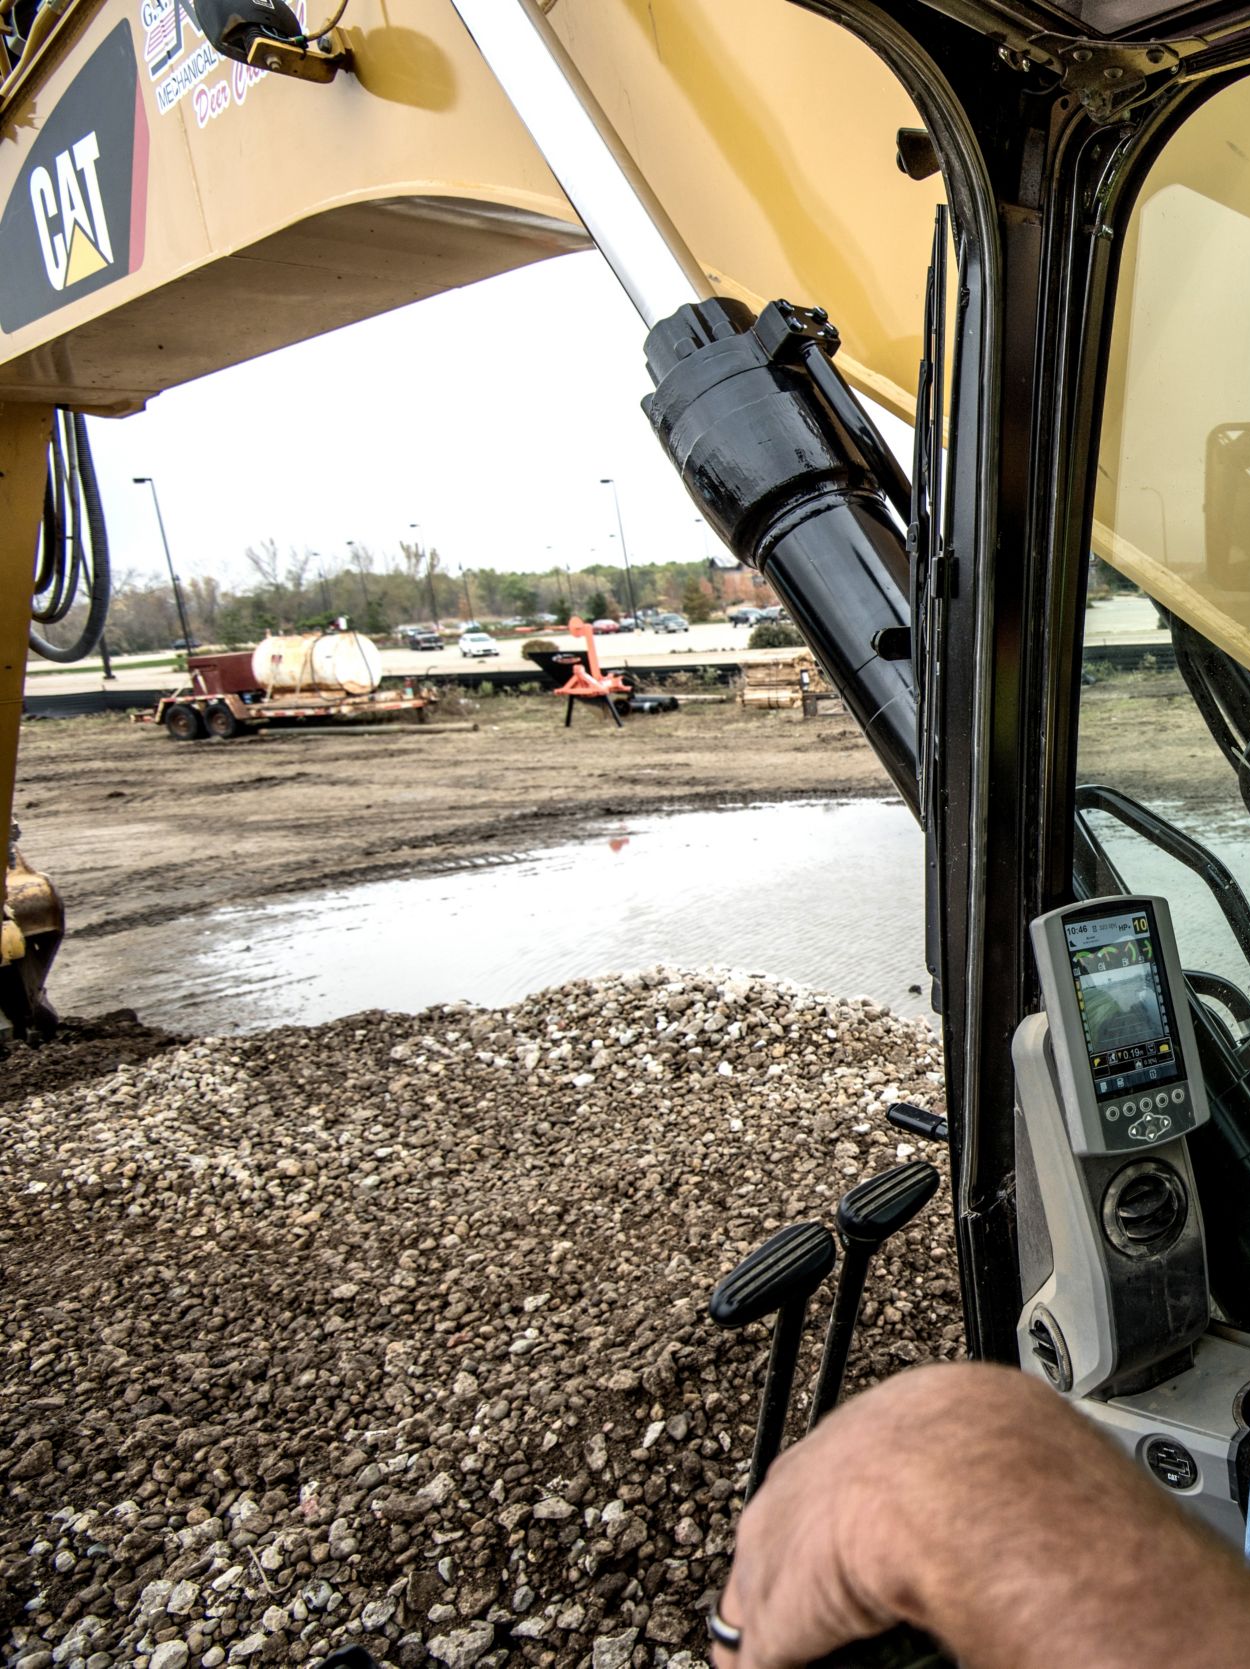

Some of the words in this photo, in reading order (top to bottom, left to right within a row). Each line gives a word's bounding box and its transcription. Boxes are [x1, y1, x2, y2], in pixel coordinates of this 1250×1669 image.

[195, 86, 229, 123] Deer
[30, 130, 114, 291] CAT
[1066, 925, 1088, 935] 10:46
[1133, 918, 1147, 932] 10
[1167, 1473, 1178, 1481] CAT
